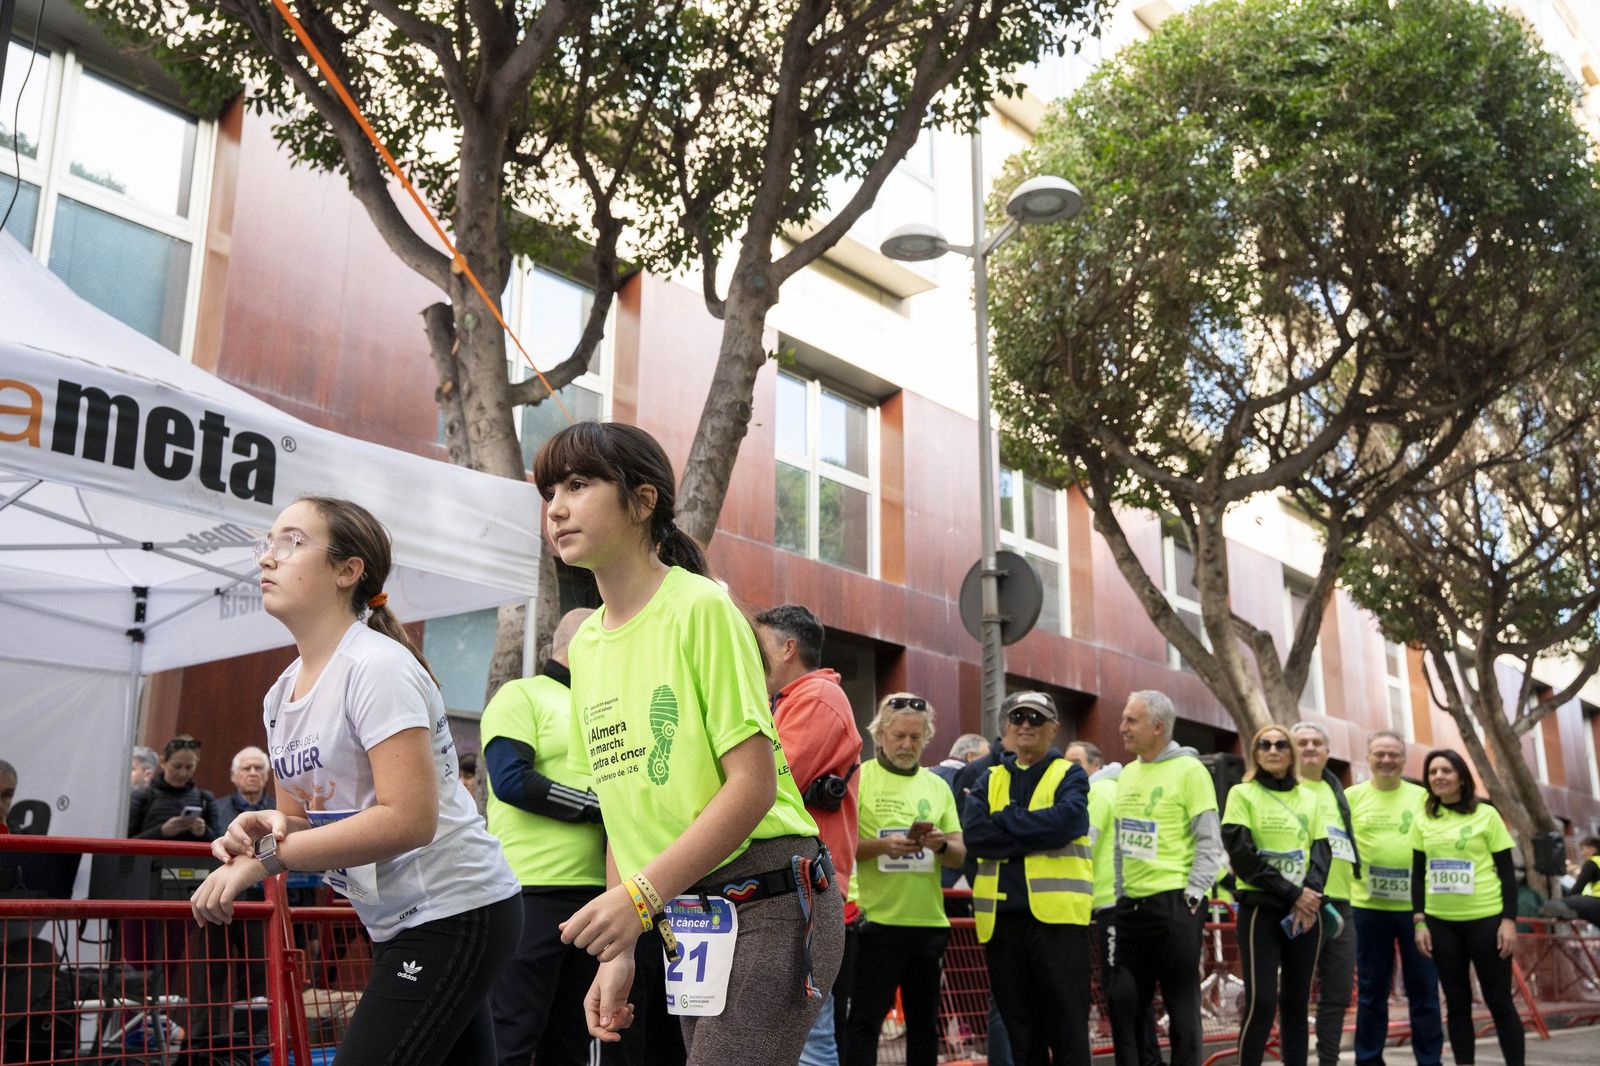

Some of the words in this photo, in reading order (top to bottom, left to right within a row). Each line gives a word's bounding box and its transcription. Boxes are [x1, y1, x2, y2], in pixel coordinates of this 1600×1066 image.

[274, 746, 324, 780] MUJER
[1121, 831, 1153, 849] 1442
[1371, 877, 1409, 892] 1253
[1431, 871, 1471, 884] 1800
[676, 918, 710, 928] cáncer
[397, 971, 418, 982] adidas
